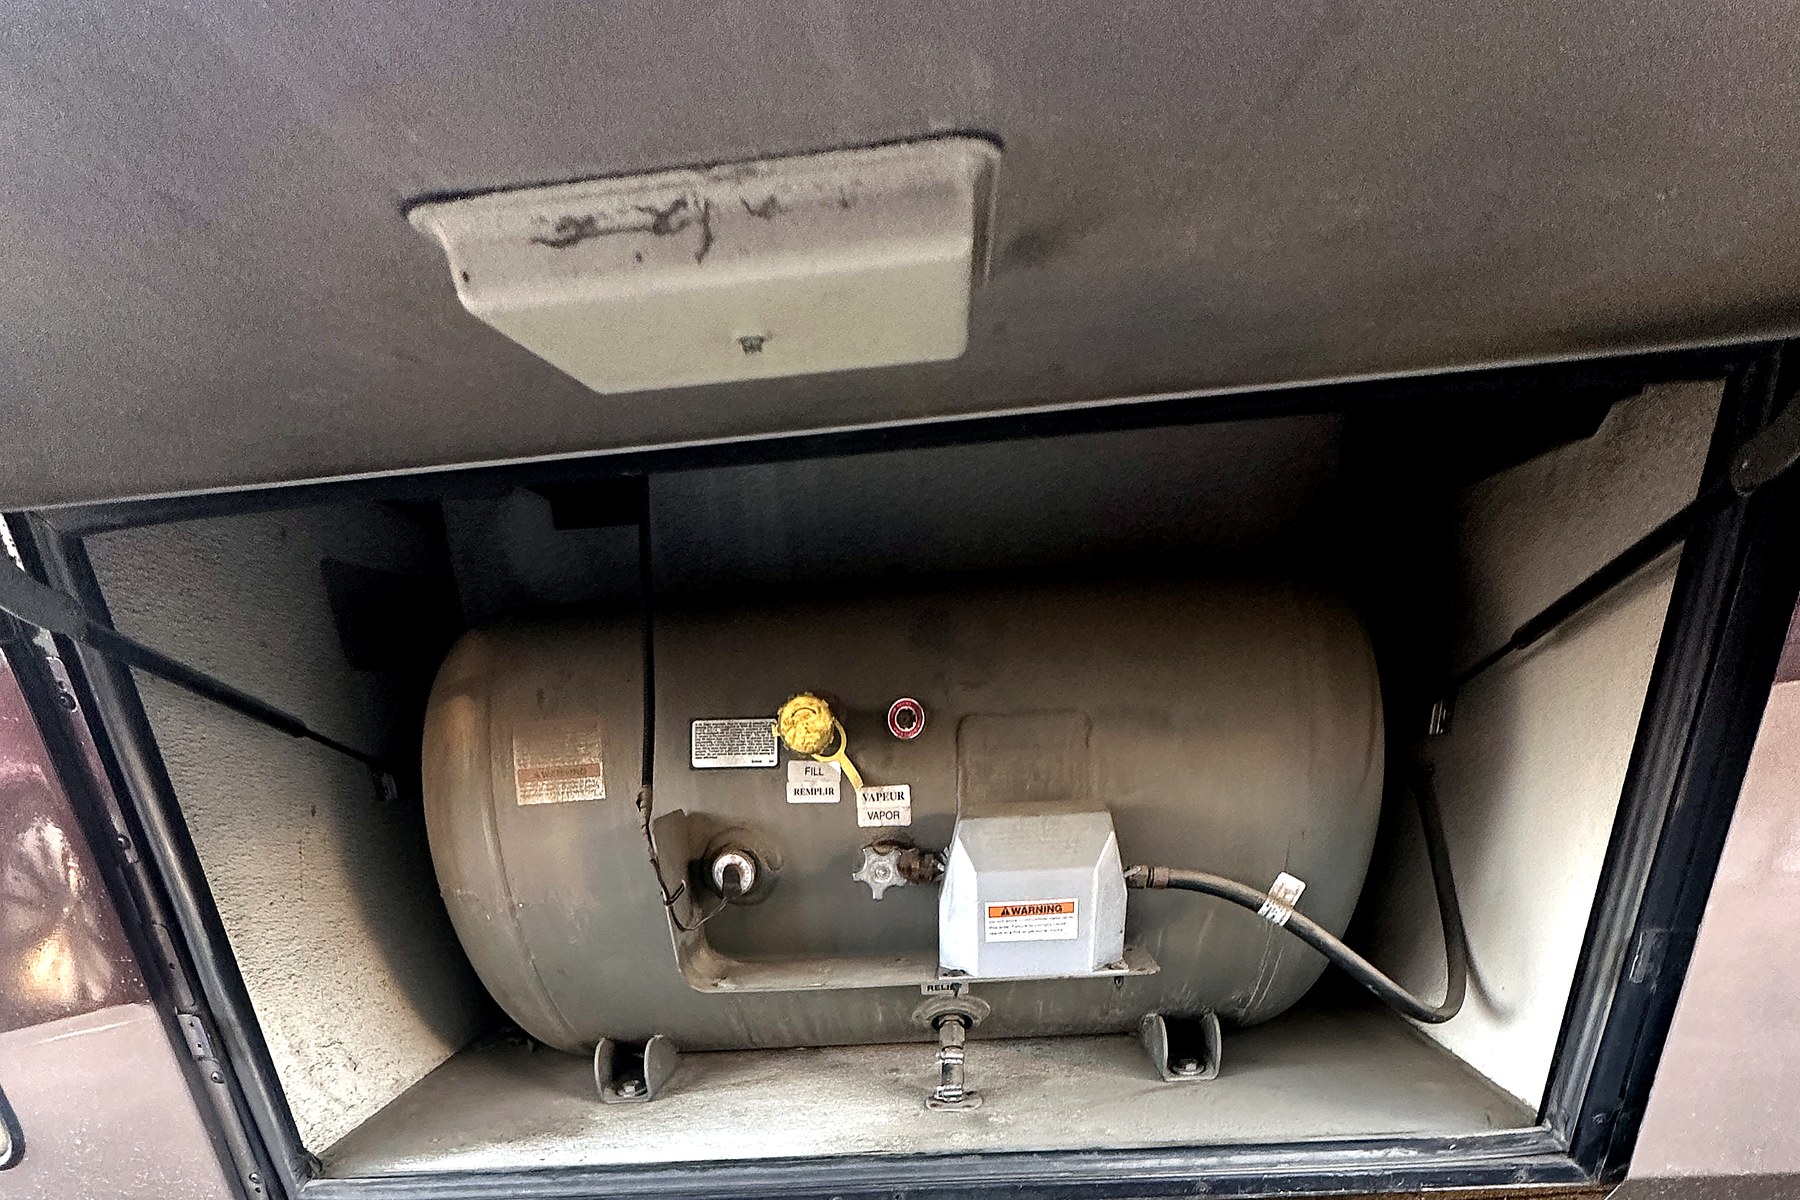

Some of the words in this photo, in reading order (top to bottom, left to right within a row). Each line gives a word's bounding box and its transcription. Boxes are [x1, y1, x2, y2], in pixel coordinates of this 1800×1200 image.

[804, 766, 825, 777] FILL
[793, 787, 835, 797] REMPLIR
[862, 791, 905, 802] VAPEUR
[867, 810, 901, 821] VAPOR
[1011, 904, 1064, 916] WARNING
